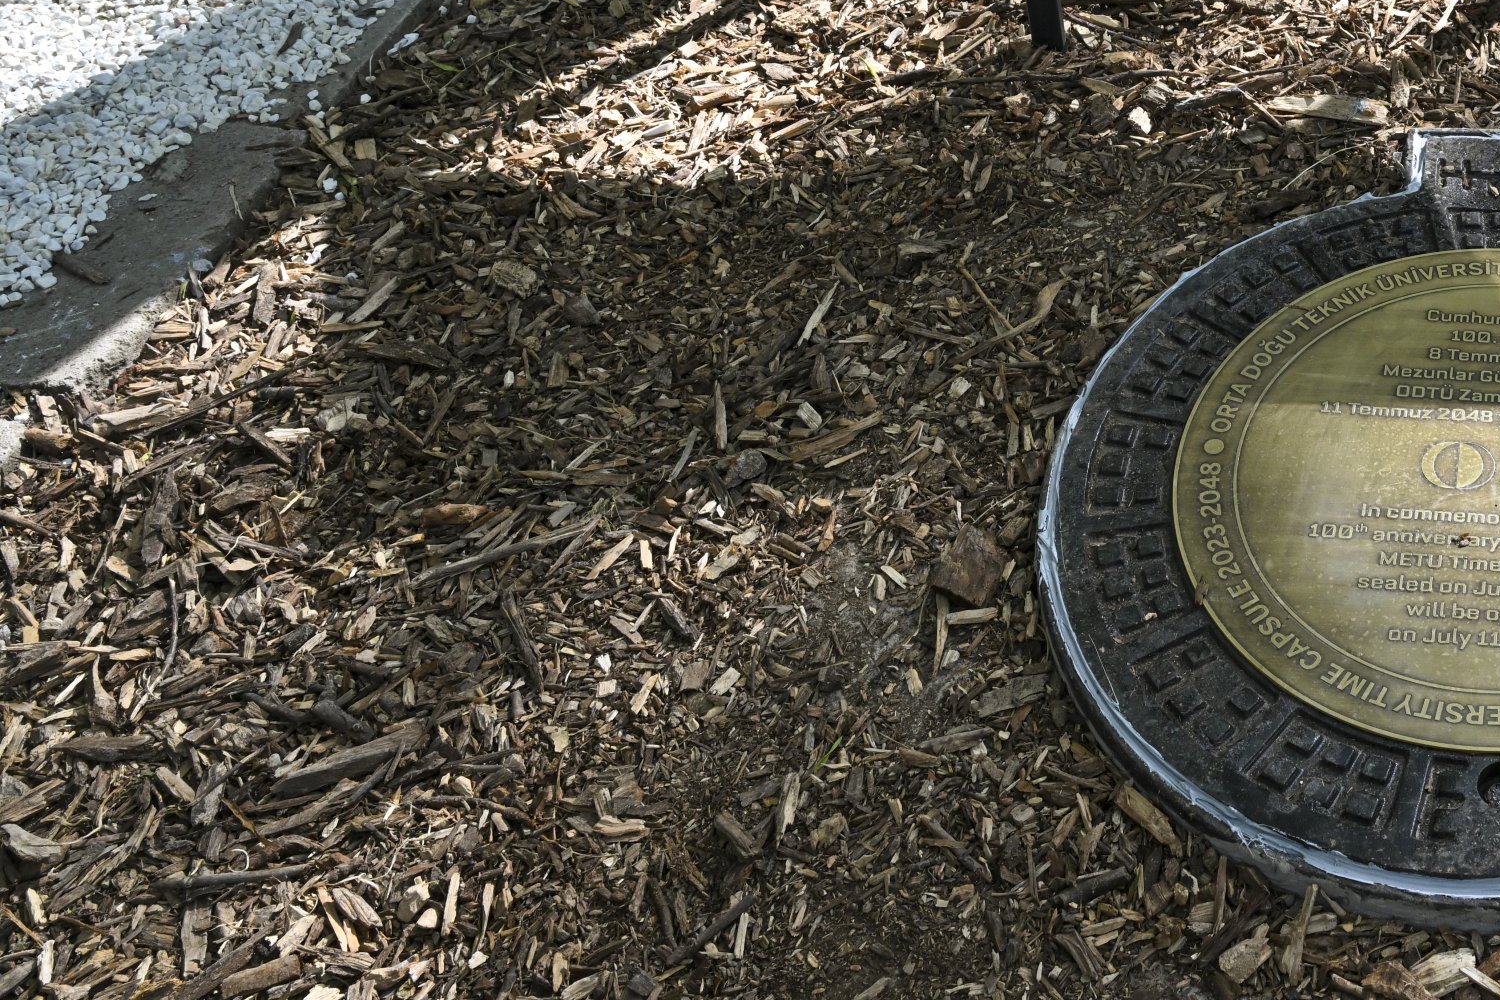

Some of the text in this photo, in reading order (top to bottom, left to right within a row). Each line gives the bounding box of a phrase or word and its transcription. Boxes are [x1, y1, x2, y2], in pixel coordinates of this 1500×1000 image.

[1451, 331, 1497, 344] 100.
[1211, 382, 1252, 433] ORTA
[1241, 328, 1296, 380] DOĞU
[1291, 284, 1377, 332] TEKNİK
[1429, 348, 1440, 359] 8
[1383, 364, 1474, 382] Mezunlar
[1396, 384, 1453, 400] ODTÜ
[1320, 402, 1342, 414] 11
[1348, 402, 1431, 420] Temmuz
[1438, 408, 1493, 422] 2048
[1361, 504, 1380, 518] In
[1200, 462, 1241, 579] 2023-2048
[1372, 528, 1500, 552] anniverary
[1379, 552, 1443, 568] METU
[1357, 576, 1433, 592] sealed
[1439, 580, 1467, 594] on
[1407, 603, 1445, 618] will
[1452, 604, 1479, 620] be
[1226, 579, 1322, 670] CAPSULE
[1388, 628, 1415, 642] on
[1423, 628, 1471, 649] July
[1319, 662, 1391, 708] TIME
